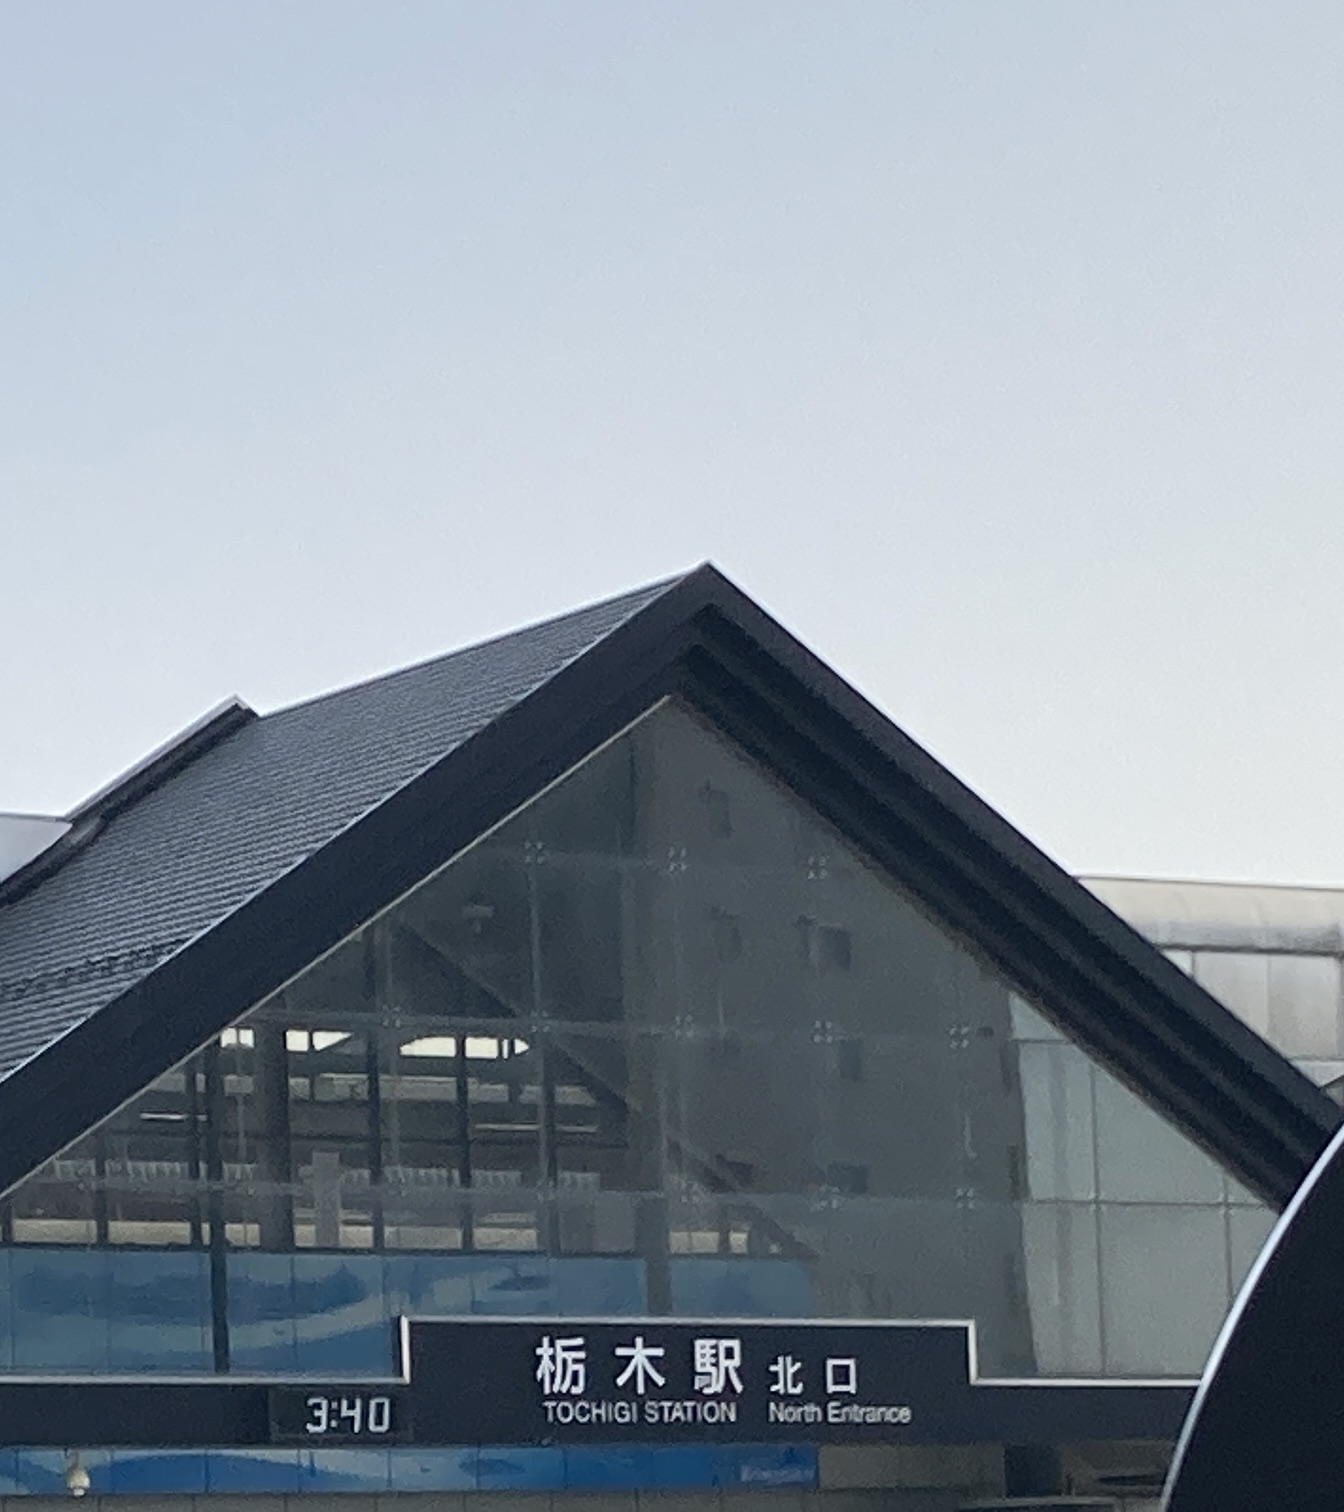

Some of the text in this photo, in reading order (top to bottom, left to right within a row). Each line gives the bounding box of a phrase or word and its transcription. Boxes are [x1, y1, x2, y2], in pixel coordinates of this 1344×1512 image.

[535, 1335, 857, 1395] 栃木駅 北口
[305, 1397, 390, 1434] 3:40
[543, 1400, 912, 1424] TOCHIGI STATION North Entrance
